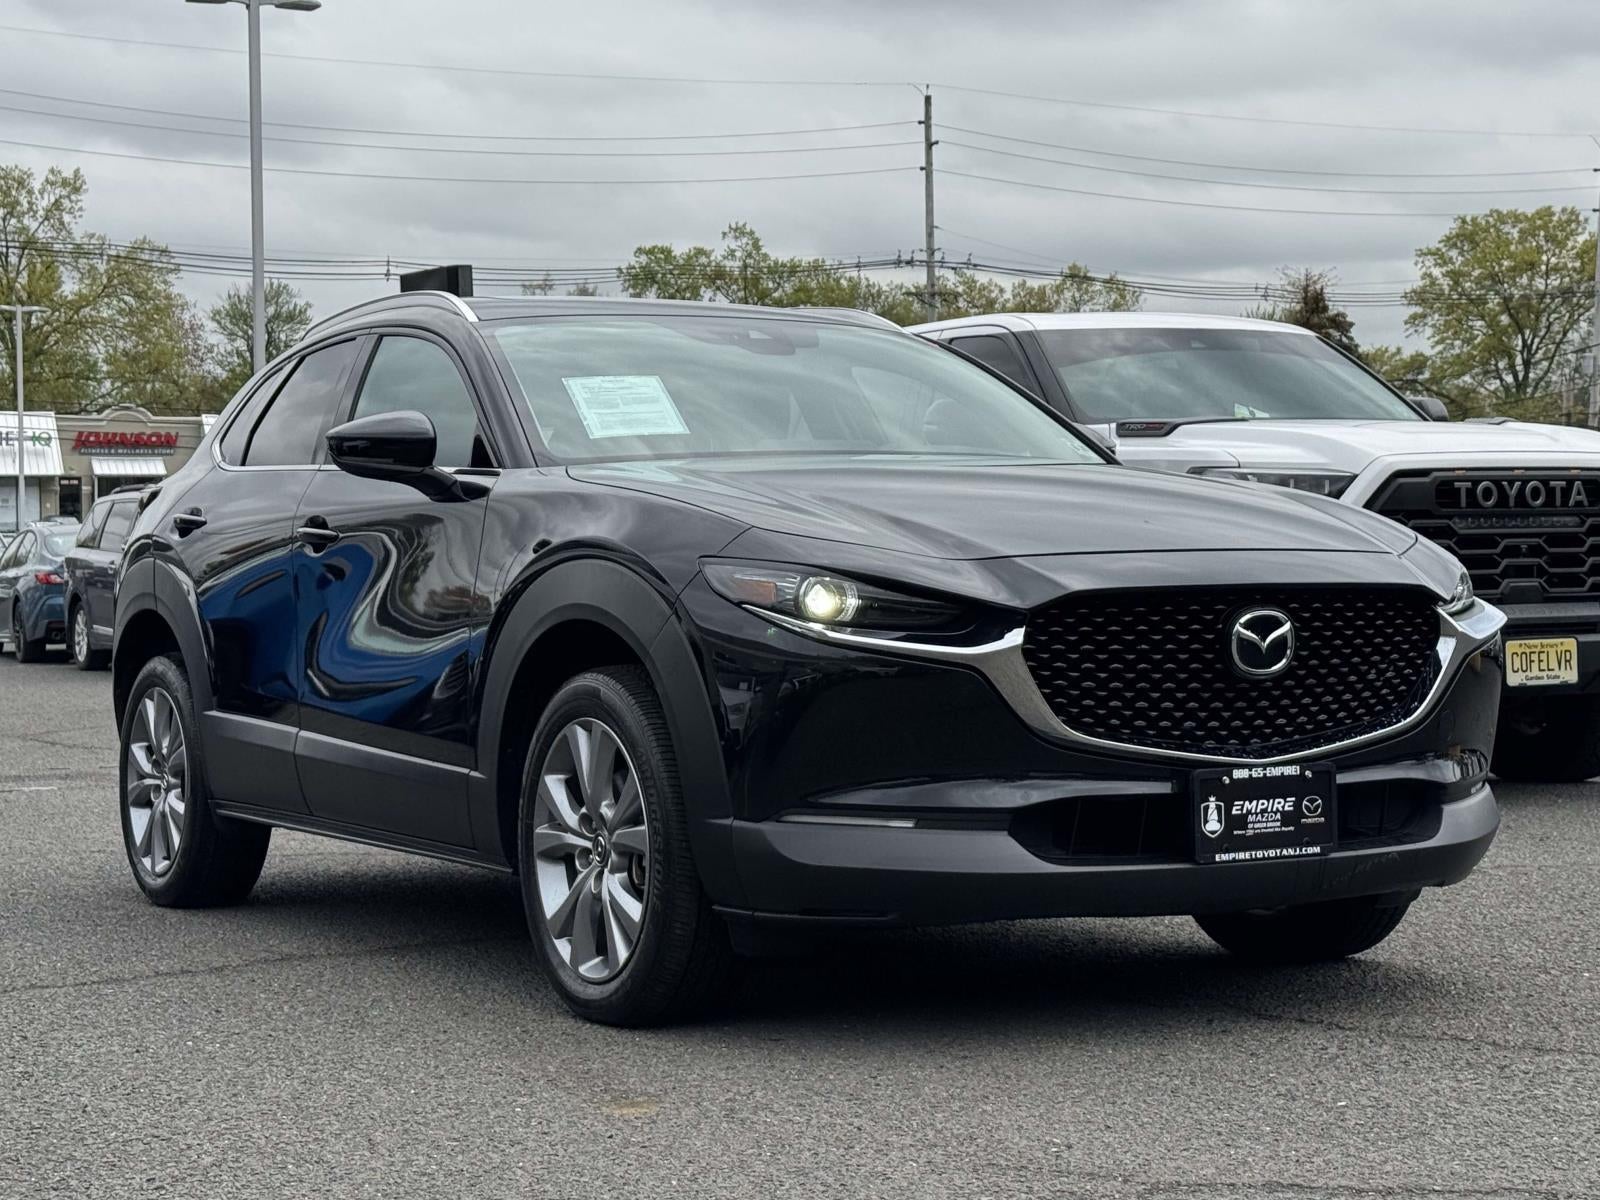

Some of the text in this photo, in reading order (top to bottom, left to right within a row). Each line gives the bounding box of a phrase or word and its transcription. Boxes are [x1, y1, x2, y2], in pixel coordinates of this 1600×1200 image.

[72, 431, 179, 450] JOHNSON
[1454, 480, 1589, 508] TOYOTA
[1540, 641, 1559, 649] Jersey
[1511, 649, 1573, 673] COFELVR
[1232, 797, 1296, 814] EMPIRE
[1247, 812, 1281, 822] MAZDA
[1215, 846, 1321, 862] EMPIRETOYOTANJ.COM
